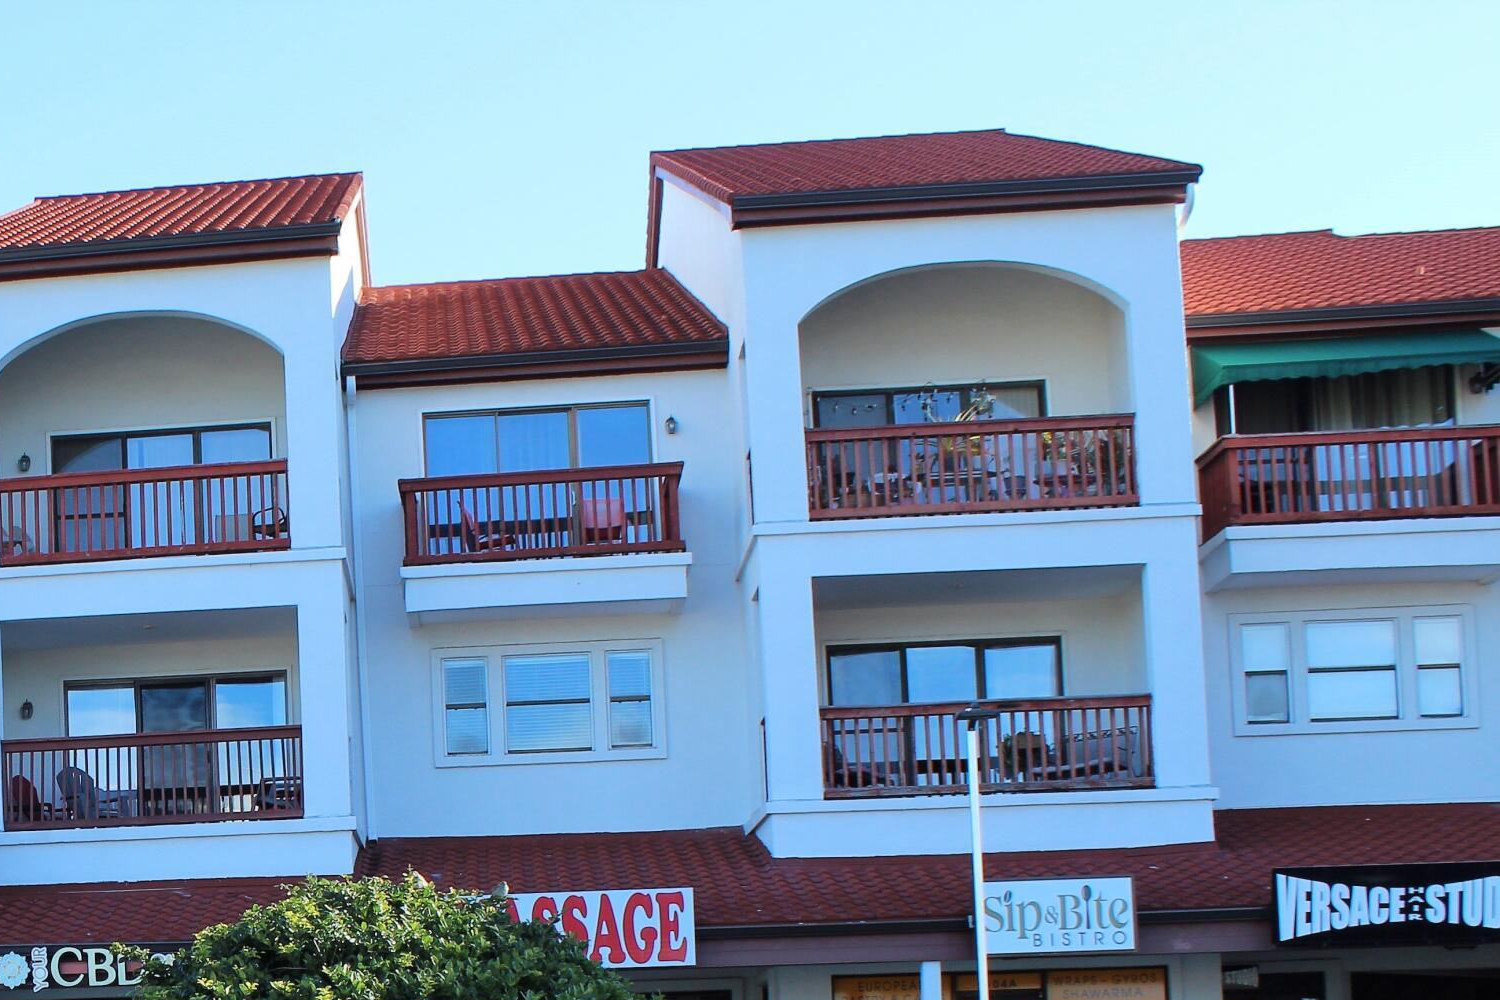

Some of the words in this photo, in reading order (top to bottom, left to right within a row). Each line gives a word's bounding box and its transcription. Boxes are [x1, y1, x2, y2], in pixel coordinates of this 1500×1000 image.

[1275, 873, 1406, 942] VERSACE
[504, 891, 688, 964] SAGE
[1032, 930, 1127, 947] BISTRO
[31, 946, 50, 993] YOUR
[857, 980, 919, 993] EUROPEA
[992, 979, 1017, 989] 04A
[1052, 974, 1099, 987] WRAPS
[1112, 972, 1158, 984] GYROS
[1062, 986, 1144, 999] SHAWARMA
